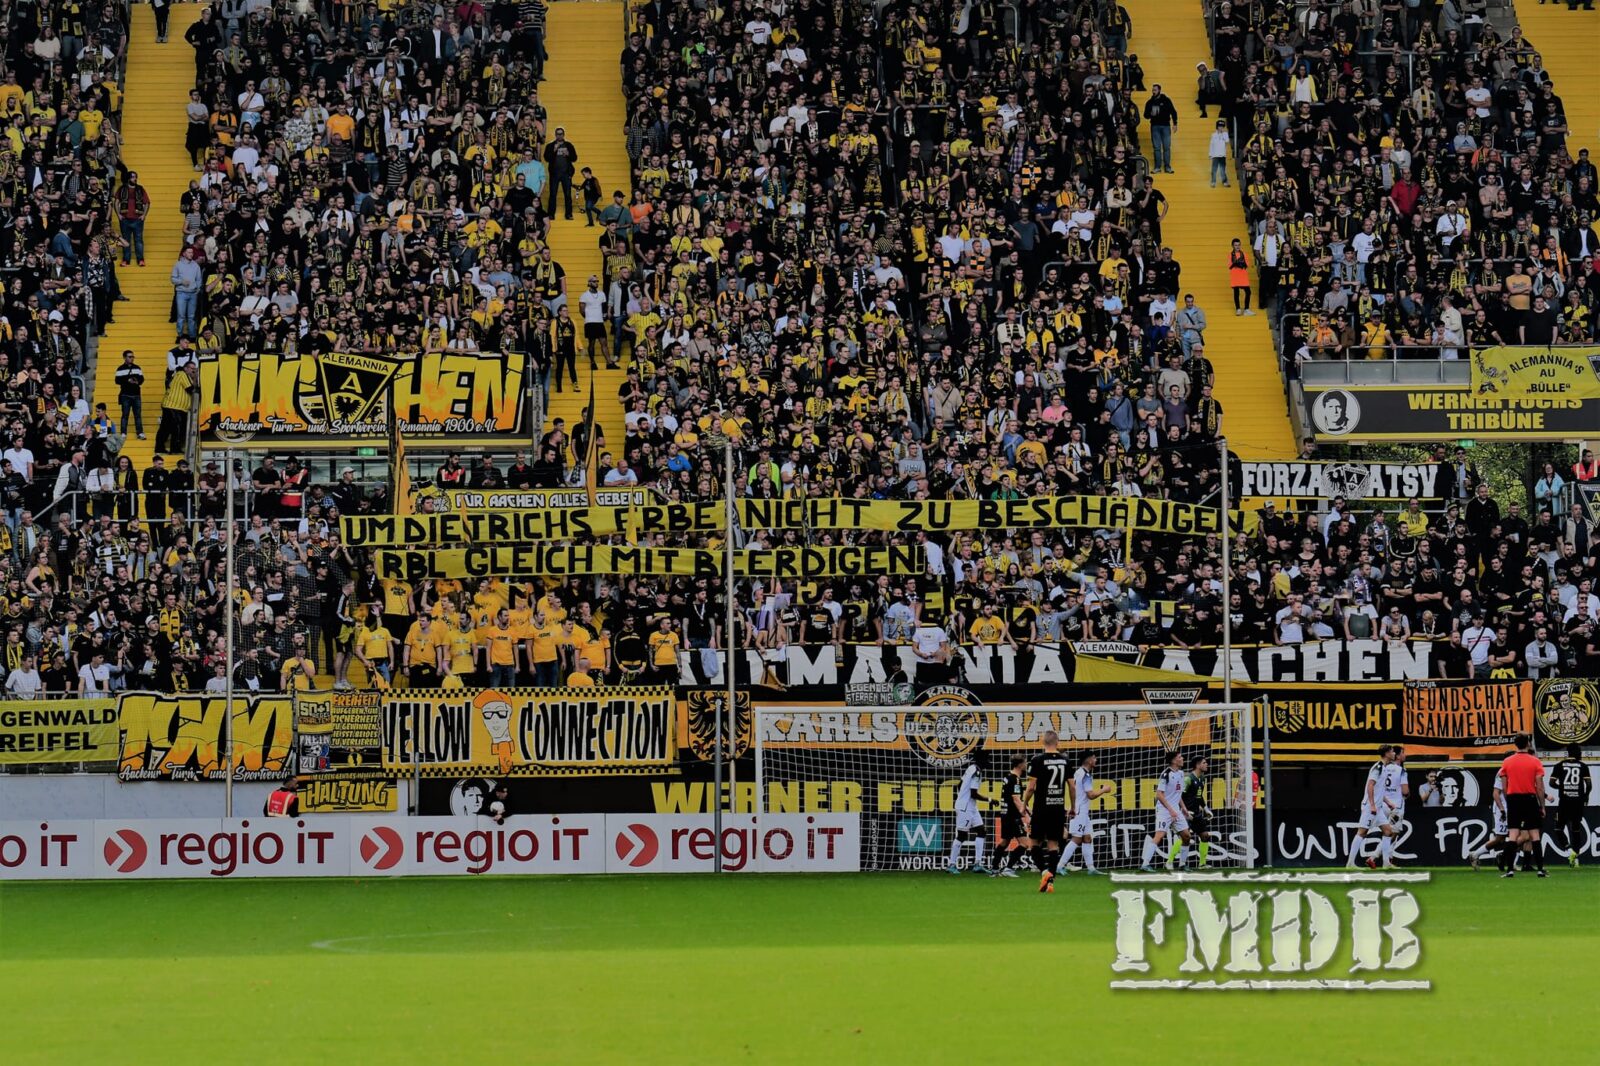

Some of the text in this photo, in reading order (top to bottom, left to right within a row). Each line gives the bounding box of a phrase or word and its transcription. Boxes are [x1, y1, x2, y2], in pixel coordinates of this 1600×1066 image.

[321, 352, 391, 373] ALEMANNIA
[1540, 368, 1555, 377] AU
[340, 371, 363, 393] A
[1408, 393, 1583, 410] WERNER FUCHS
[219, 419, 263, 433] Aachener
[266, 416, 303, 434] Turn-
[307, 420, 328, 434] und
[329, 418, 387, 436] Sportverein
[397, 419, 442, 433] lemannia
[1447, 410, 1545, 430] TRIBÜNE
[1242, 463, 1439, 498] FORZA ATSV
[455, 493, 485, 507] FÜR
[489, 494, 545, 508] AACHEN
[549, 493, 588, 507] ALLES
[597, 491, 644, 506] GEBEN!
[345, 516, 395, 545] UM
[404, 509, 592, 544] DIETRICHS
[616, 501, 717, 531] ERBE
[745, 500, 871, 528] NICHT
[896, 501, 952, 530] ZU
[382, 546, 925, 579] RBL GLEICH MIT BEERDIGEN!
[1078, 643, 1140, 654] ALEMANNIA
[926, 685, 970, 699] KARLS
[1150, 690, 1196, 699] ALEMANNIA
[762, 712, 898, 742] KARLS
[996, 712, 1140, 742] BANDE
[1307, 702, 1397, 731] WACHT
[383, 700, 669, 763] YELLOW CONNECTION
[1047, 765, 1065, 789] 21
[1563, 766, 1580, 785] 28
[306, 781, 388, 807] HALTUNG
[651, 781, 862, 813] WERNER
[902, 824, 937, 847] W
[1078, 823, 1086, 833] 24
[160, 820, 285, 876] regio
[416, 817, 540, 874] regio
[671, 816, 794, 871] regio
[900, 856, 951, 870] WORLD
[955, 856, 973, 870] OF
